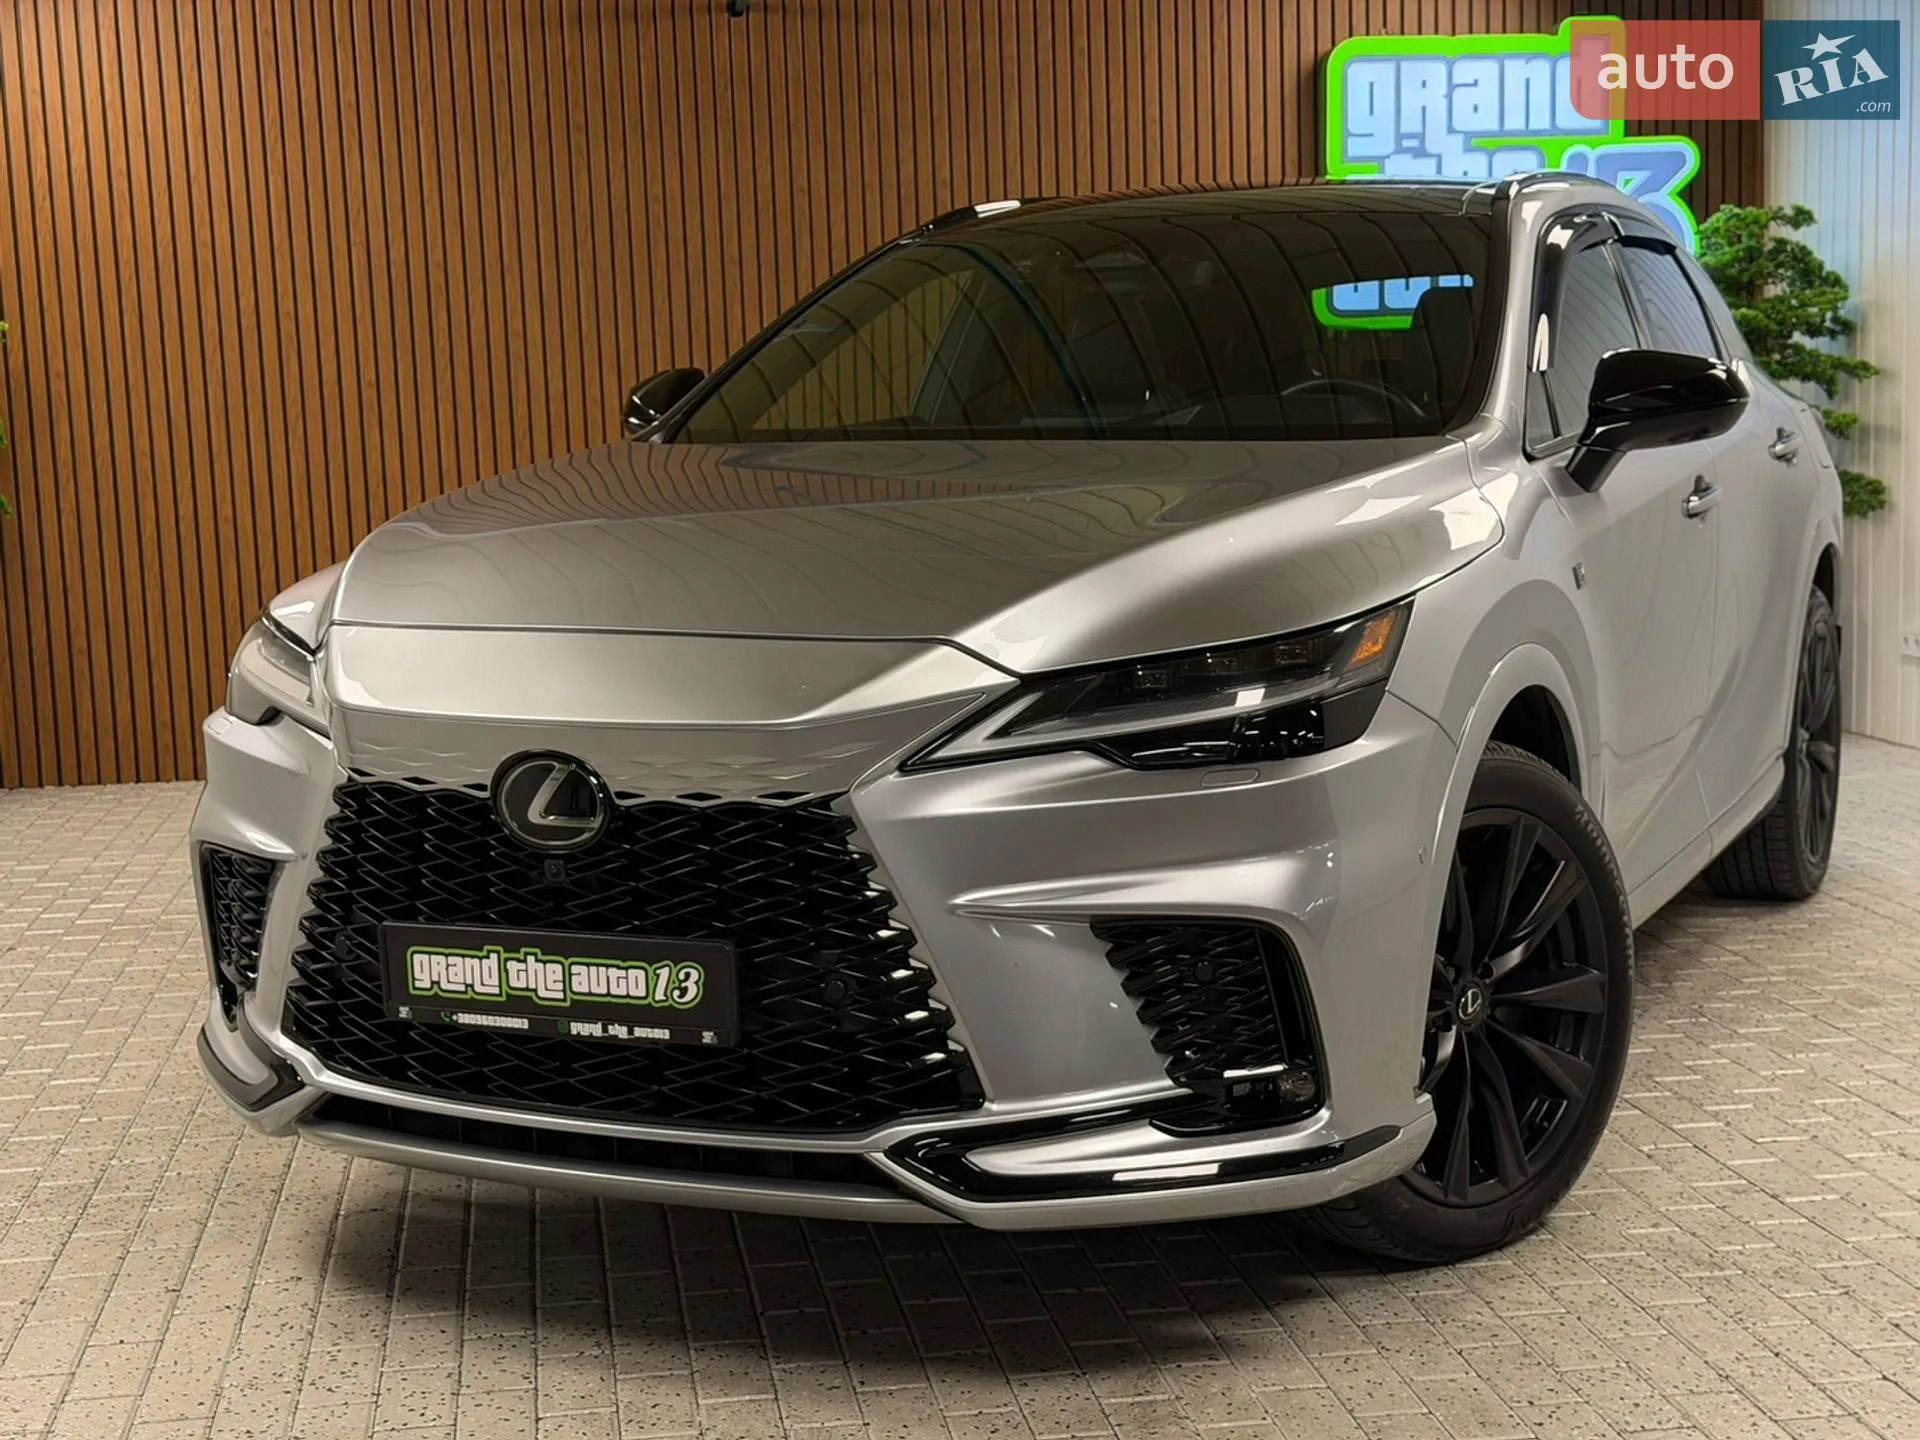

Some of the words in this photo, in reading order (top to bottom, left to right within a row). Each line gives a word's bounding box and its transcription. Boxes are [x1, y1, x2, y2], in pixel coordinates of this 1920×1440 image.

[413, 952, 500, 995] grand
[506, 955, 565, 999] the
[570, 964, 647, 998] auto
[653, 966, 699, 1003] 13
